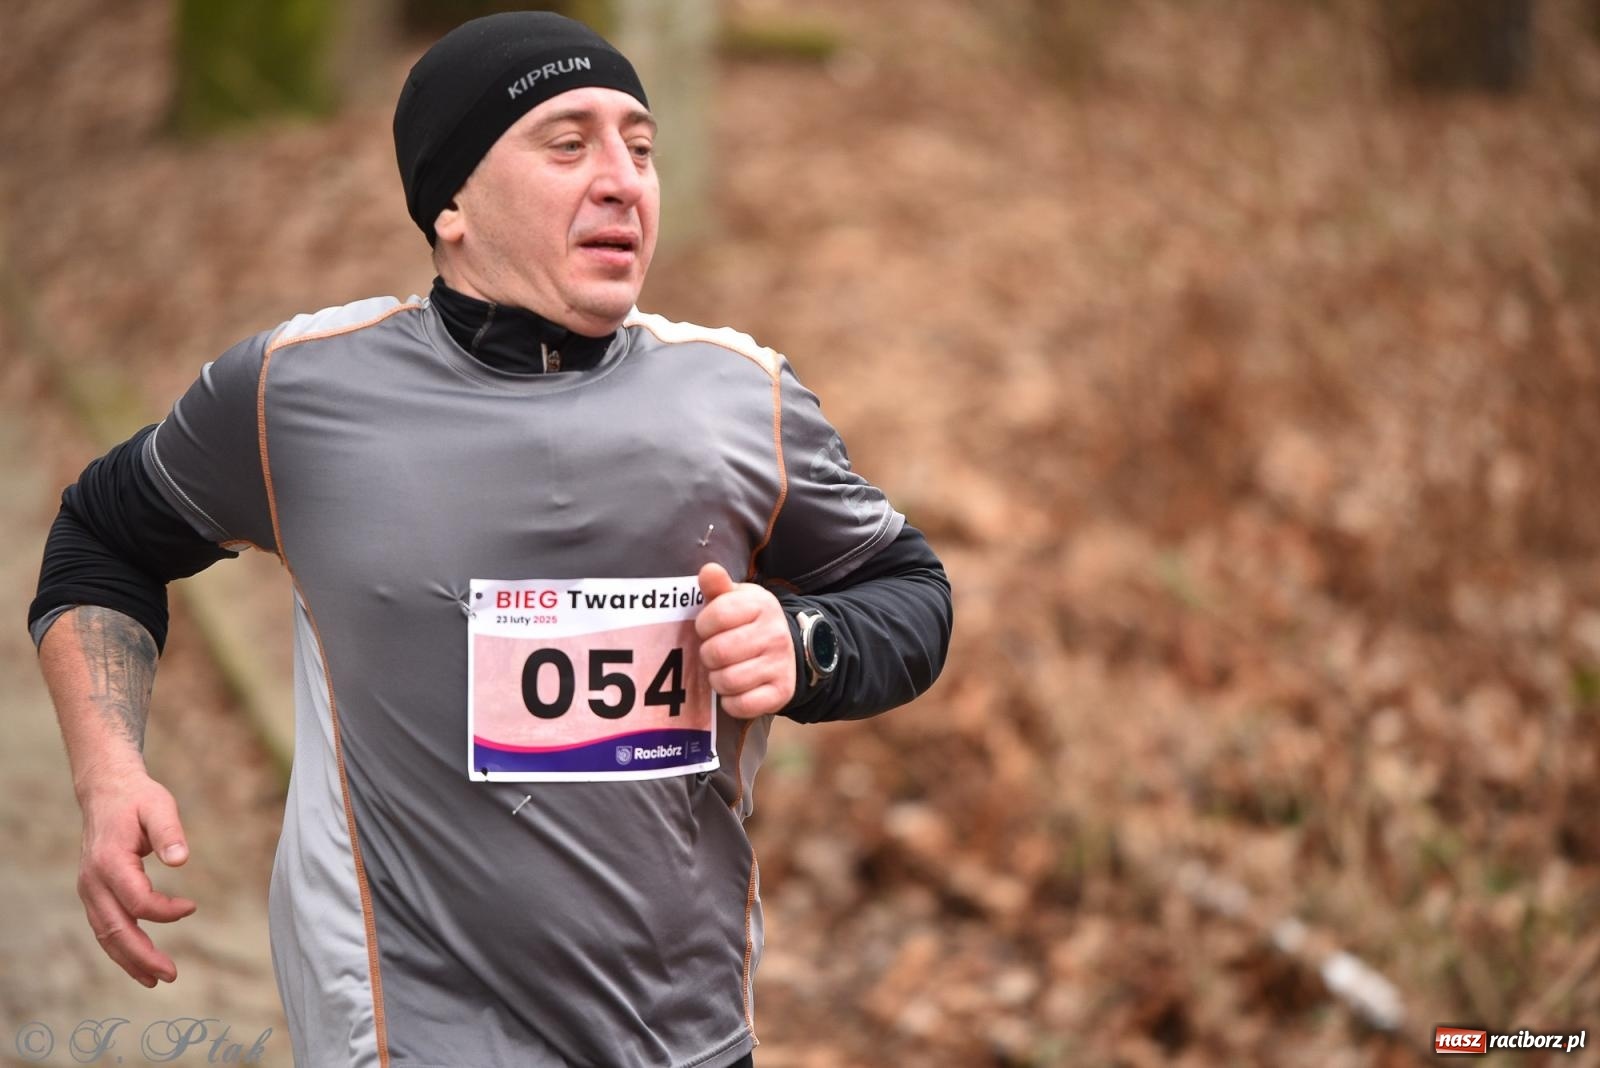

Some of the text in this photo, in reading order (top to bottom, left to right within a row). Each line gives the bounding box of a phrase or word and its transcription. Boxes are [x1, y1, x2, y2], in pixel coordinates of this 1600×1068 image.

[507, 56, 591, 100] KIPRUN
[496, 590, 558, 609] BIEG
[496, 615, 558, 626] 23 luty 2025
[521, 647, 686, 720] 054
[634, 744, 683, 760] Racibórz
